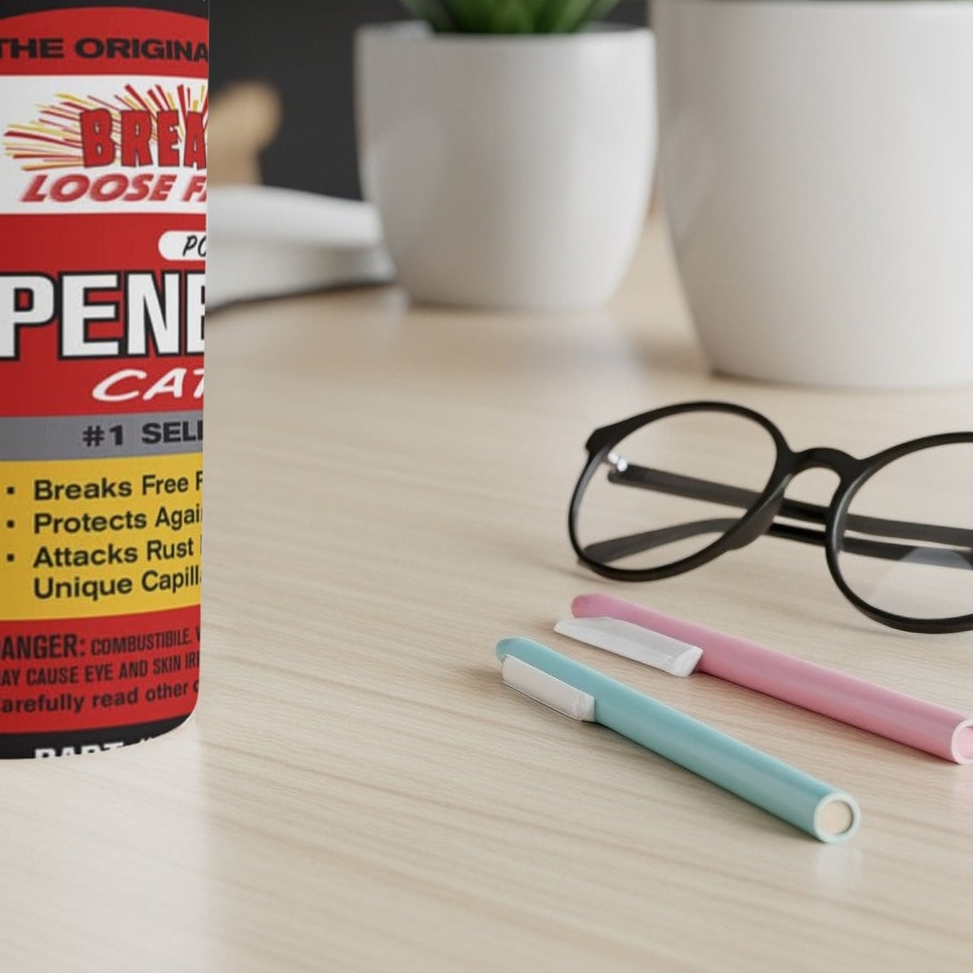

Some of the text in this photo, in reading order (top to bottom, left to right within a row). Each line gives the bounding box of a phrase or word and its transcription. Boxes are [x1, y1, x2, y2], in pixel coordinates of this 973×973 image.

[79, 108, 207, 170] BREA
[19, 173, 177, 203] LOOSE
[82, 425, 124, 447] #1
[34, 478, 132, 500] Breaks
[142, 474, 189, 495] Free
[34, 503, 203, 534] Protects Agai
[33, 543, 138, 568] Attacks
[147, 537, 194, 561] Rust
[34, 565, 202, 601] Unique Capill
[26, 665, 78, 686] CAUSE
[85, 662, 113, 683] EYE
[119, 659, 148, 680] AND
[153, 654, 181, 675] SKIN
[92, 686, 138, 708] read
[145, 682, 189, 702] other
